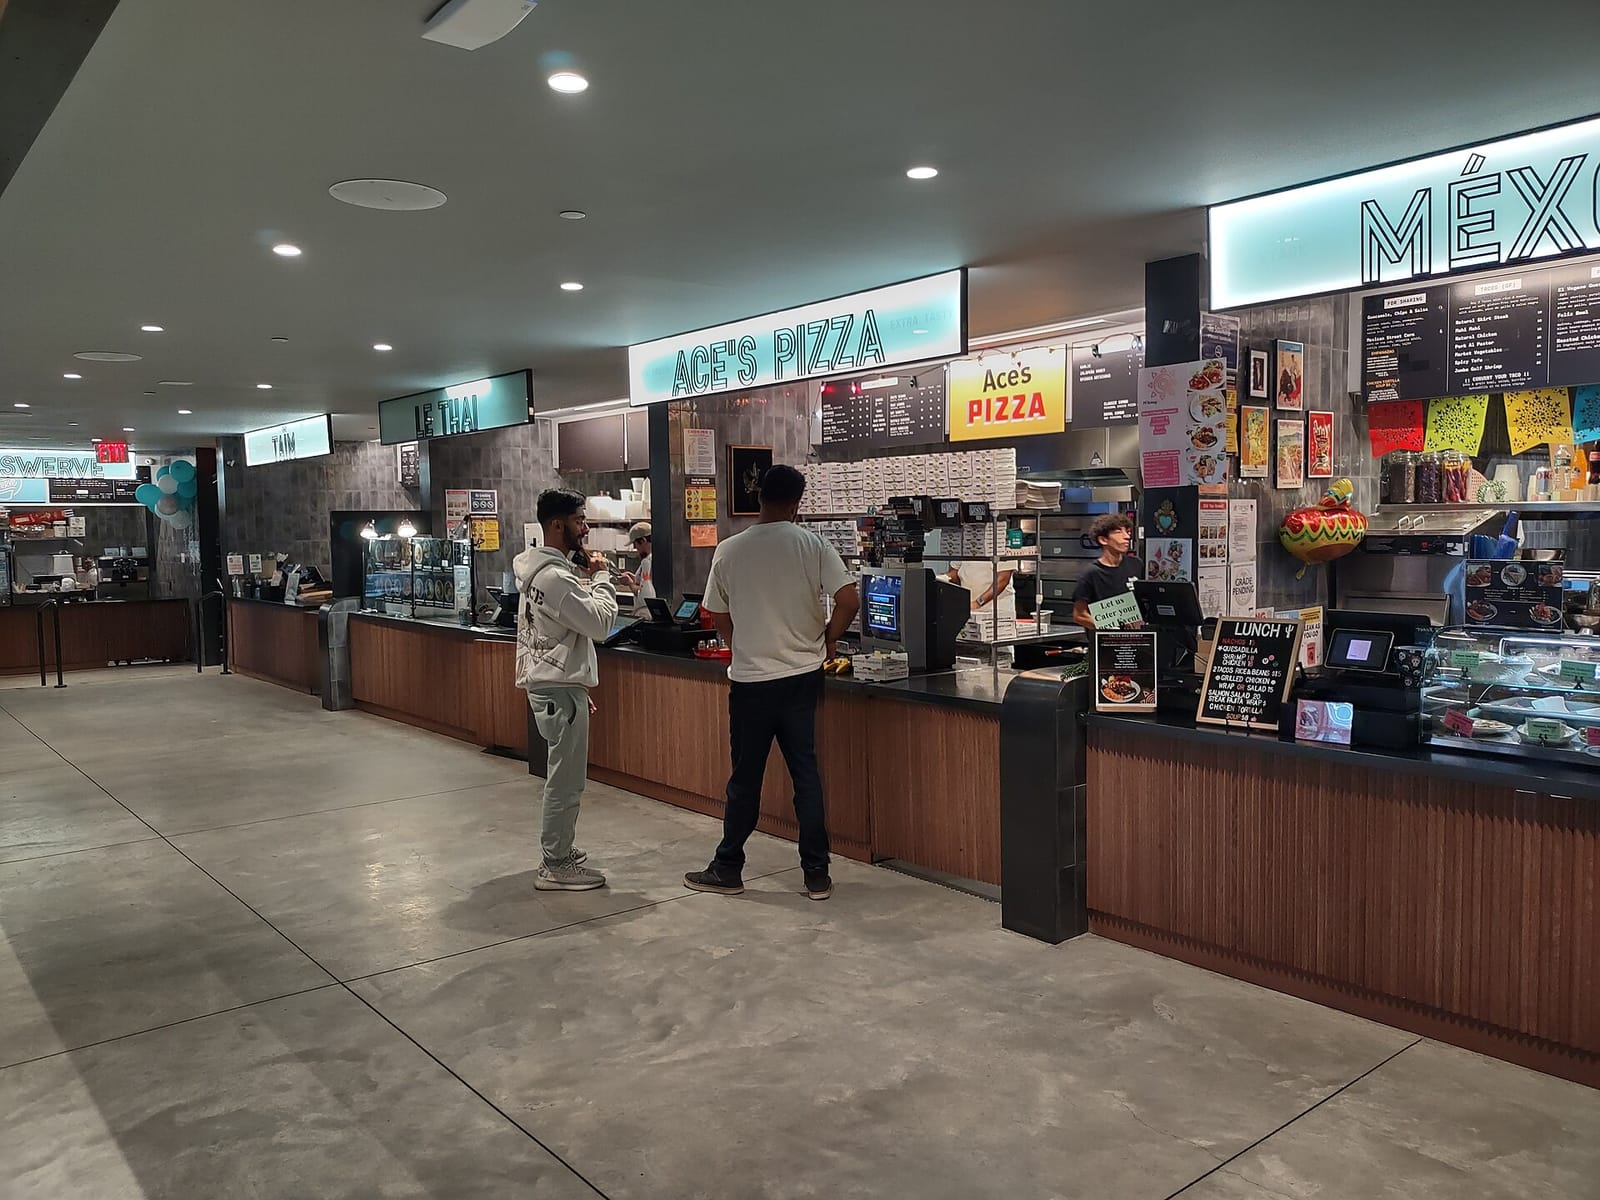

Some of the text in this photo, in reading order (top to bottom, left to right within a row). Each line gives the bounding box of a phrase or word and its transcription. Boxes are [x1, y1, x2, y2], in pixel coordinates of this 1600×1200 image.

[1361, 153, 1600, 284] MÉX
[672, 309, 886, 397] ACE'S PIZZA
[983, 361, 1032, 393] Ace's
[415, 394, 478, 440] LE THAI
[966, 392, 1047, 427] PIZZA
[99, 443, 128, 463] EXIT
[0, 455, 104, 478] SWERVE
[1235, 577, 1252, 586] GRADE
[1232, 586, 1254, 596] PENDING
[1100, 600, 1114, 610] Let
[1094, 605, 1136, 622] Cater your
[1234, 622, 1280, 638] LUNCH
[1222, 646, 1258, 654] QUESADILLA
[1220, 674, 1270, 684] GRILLED CHICKEN
[1230, 691, 1250, 699] SALAD
[1246, 684, 1266, 692] SALAD
[1209, 703, 1263, 714] CHICKEN TORTILLA
